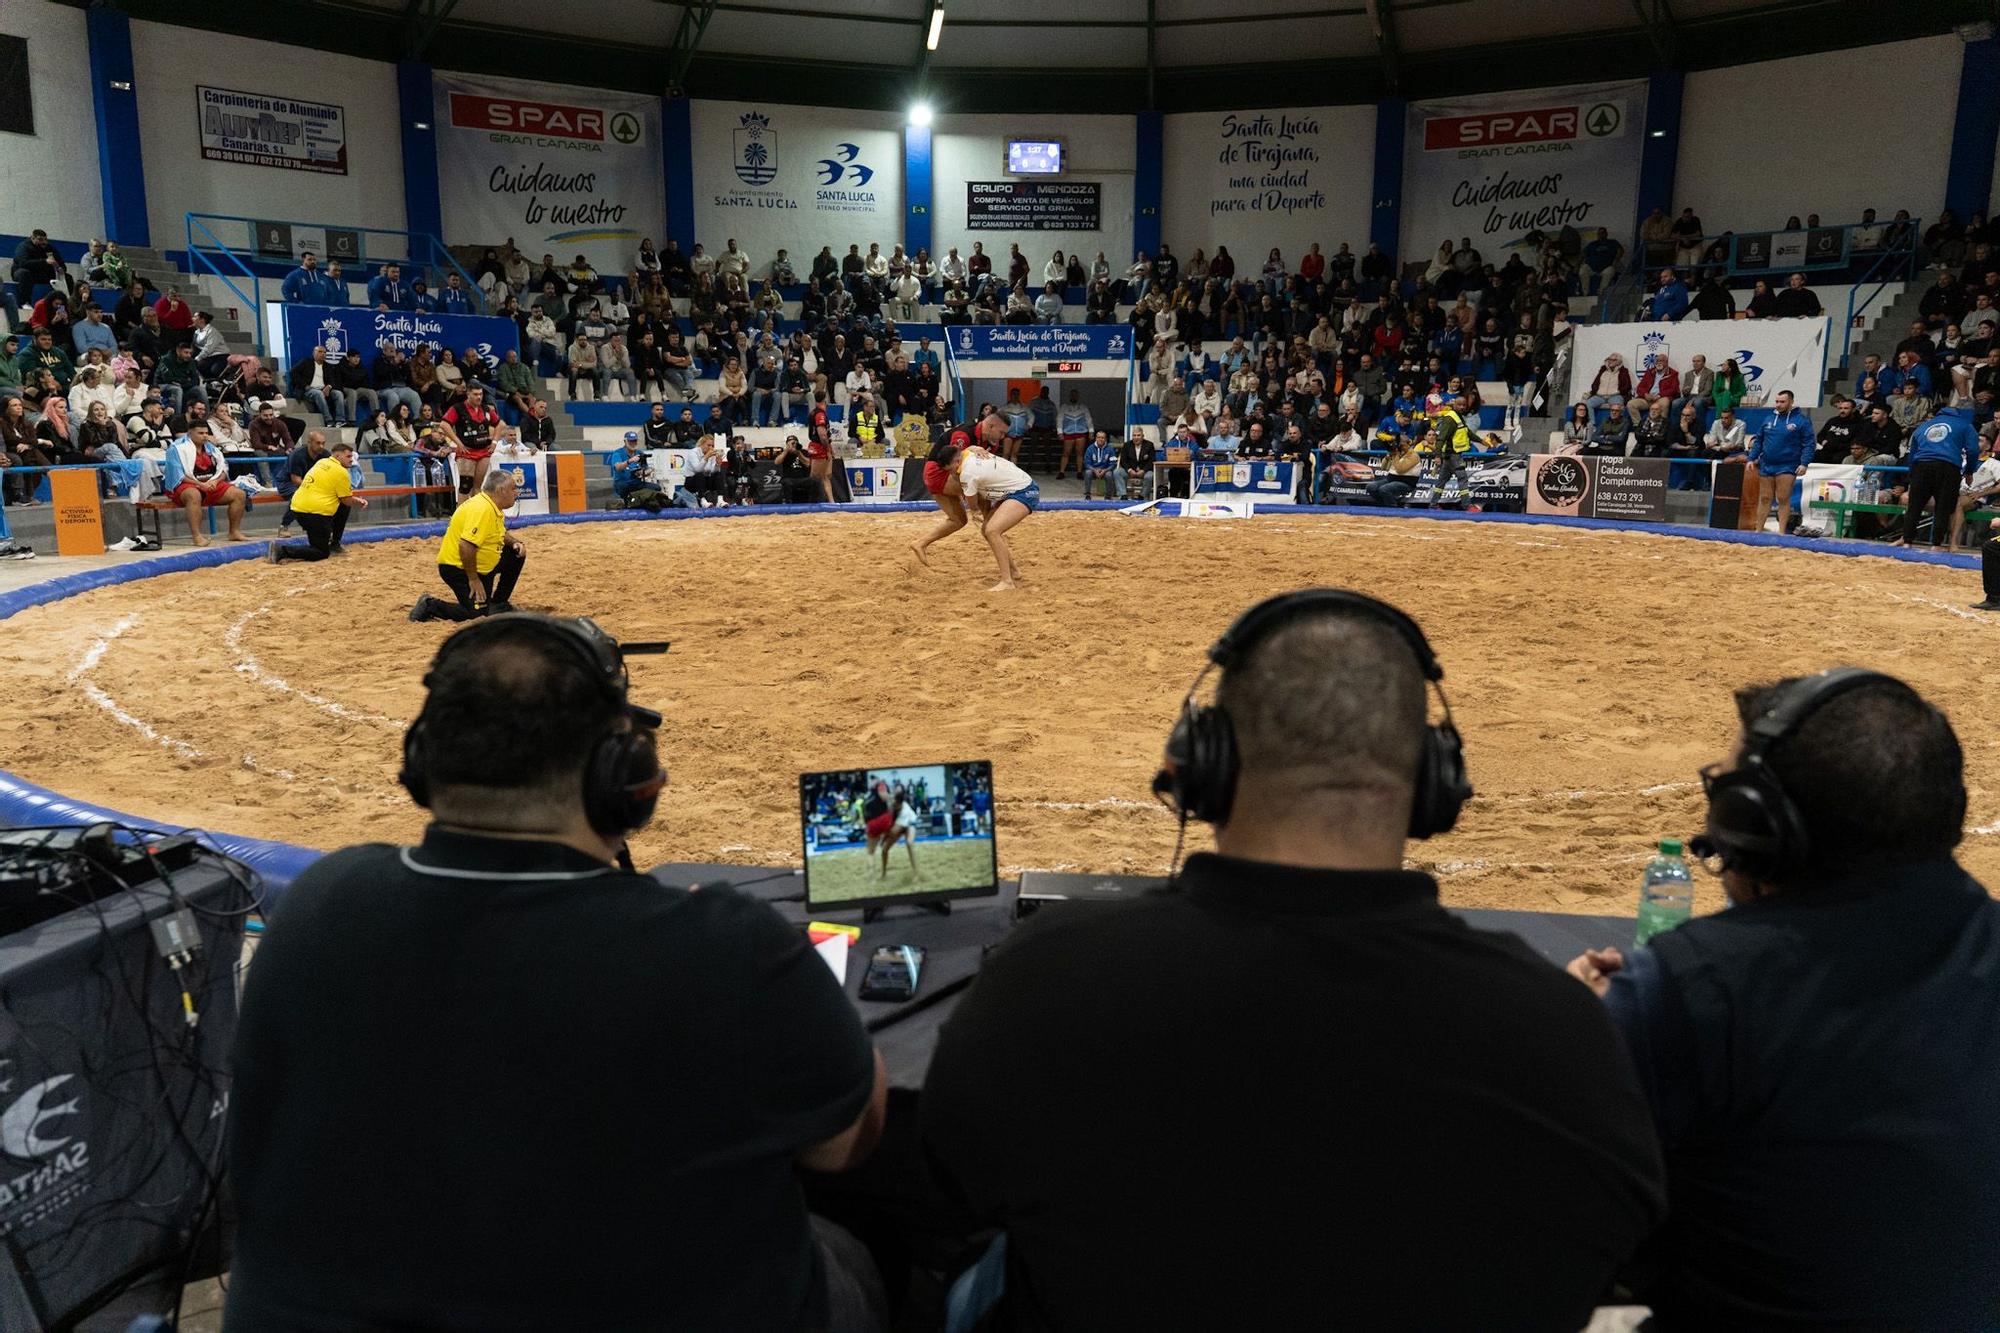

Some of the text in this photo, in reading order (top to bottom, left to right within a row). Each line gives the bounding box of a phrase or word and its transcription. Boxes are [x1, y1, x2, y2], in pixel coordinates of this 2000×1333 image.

[273, 100, 287, 112] de
[290, 104, 337, 120] Aluminio
[488, 103, 601, 136] SPAR
[1222, 115, 1319, 140] Santa Lucía
[1460, 112, 1576, 142] SPAR
[489, 133, 602, 152] GRAN CANARIA
[1458, 143, 1573, 159] GRAN CANARIA
[1220, 141, 1319, 170] de Tirajana,
[490, 162, 595, 194] Cuidamos
[1230, 170, 1308, 188] una ciudad
[817, 190, 874, 202] SANTA LUCIA
[972, 184, 1096, 194] GRUPO MENDOZA
[1452, 172, 1562, 207] Cuidamos
[714, 196, 797, 208] SANTA LUCIA
[974, 196, 1006, 204] COMPRA
[1211, 190, 1325, 216] para el Deporte
[526, 196, 627, 225] lo nuestro
[1484, 198, 1594, 234] lo nuestro
[374, 314, 442, 336] Santa Lucía
[990, 329, 1016, 341] Santa
[1017, 330, 1040, 343] Lucía
[1041, 330, 1051, 340] de
[1008, 344, 1030, 353] ciudad
[1032, 346, 1050, 355] para
[1060, 342, 1087, 354] Deporte
[1602, 456, 1624, 465] Ropa
[1600, 466, 1634, 475] Calzado
[1600, 476, 1662, 487] Complementos
[1414, 490, 1430, 498] EN
[1598, 492, 1644, 502] 638 473 293
